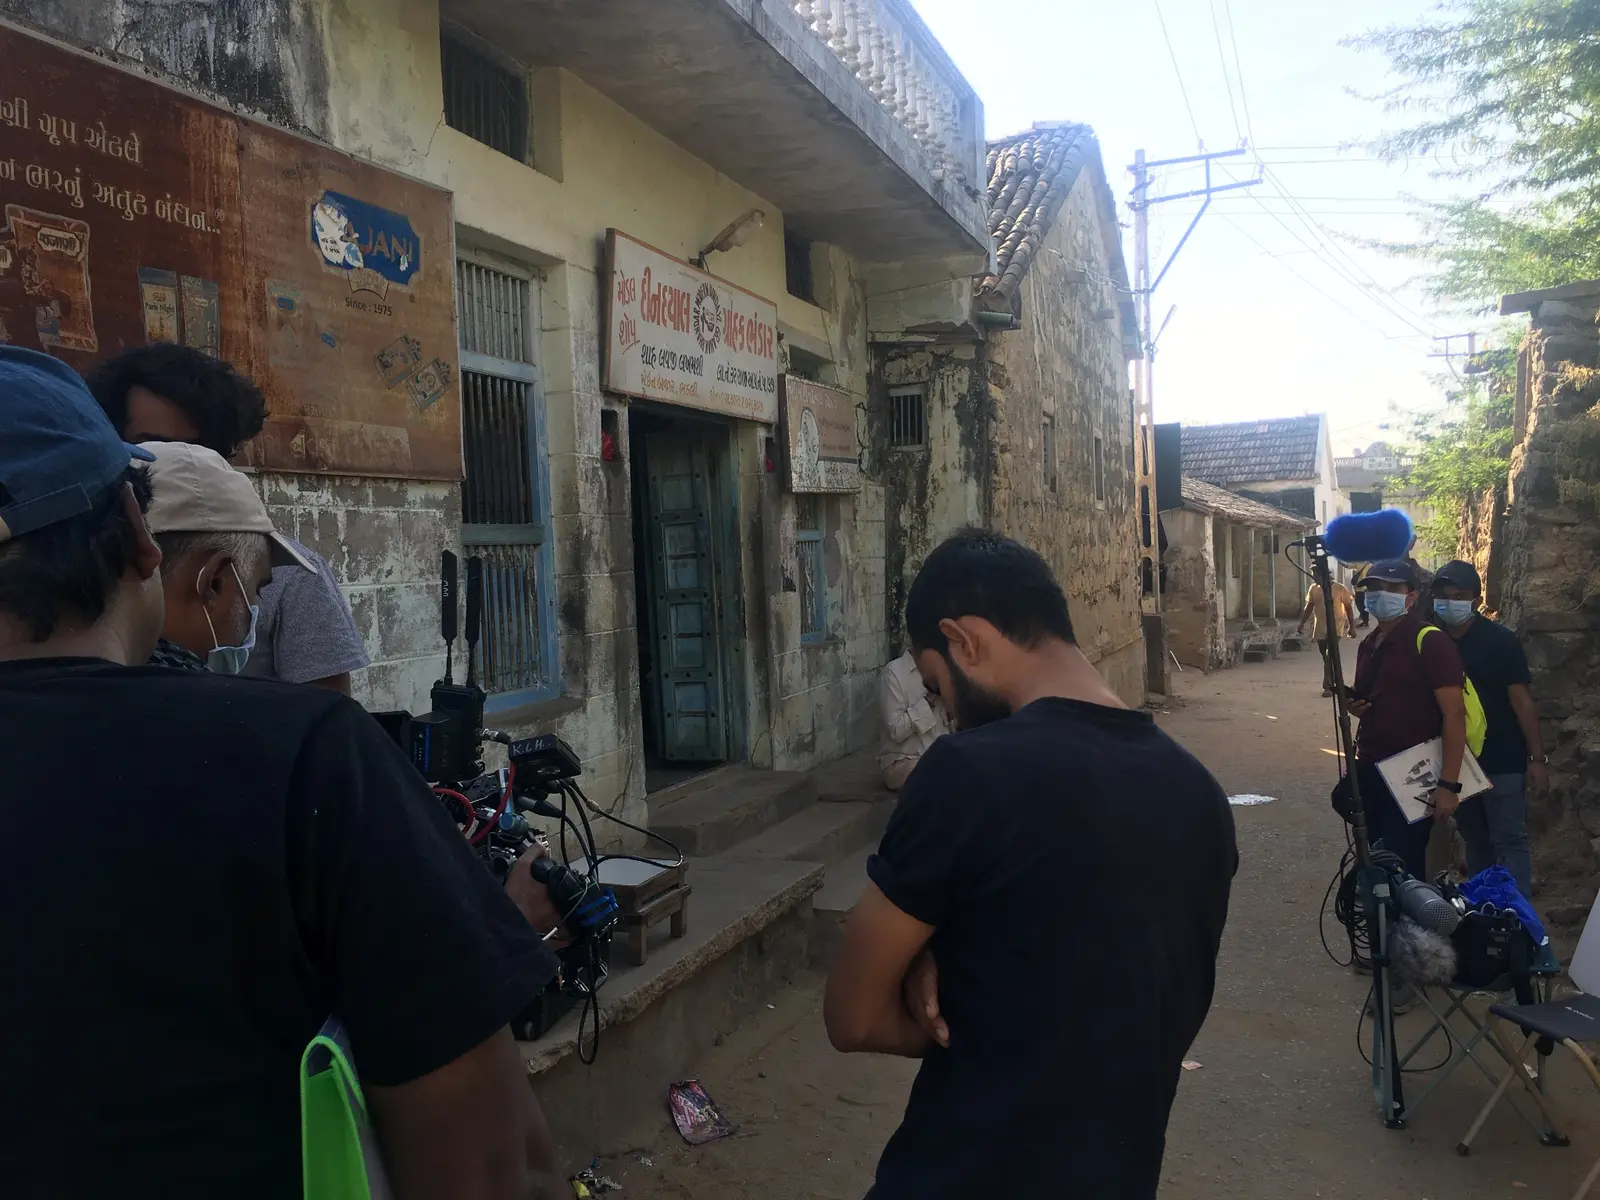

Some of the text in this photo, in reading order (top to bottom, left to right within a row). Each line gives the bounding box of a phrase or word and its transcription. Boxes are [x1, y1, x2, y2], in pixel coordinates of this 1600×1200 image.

[0, 97, 30, 130] ણી
[84, 121, 141, 163] એટલે
[26, 166, 84, 208] ભરનું
[345, 296, 367, 311] Since
[373, 303, 393, 317] 1975
[640, 266, 691, 334] દીનદયાલ
